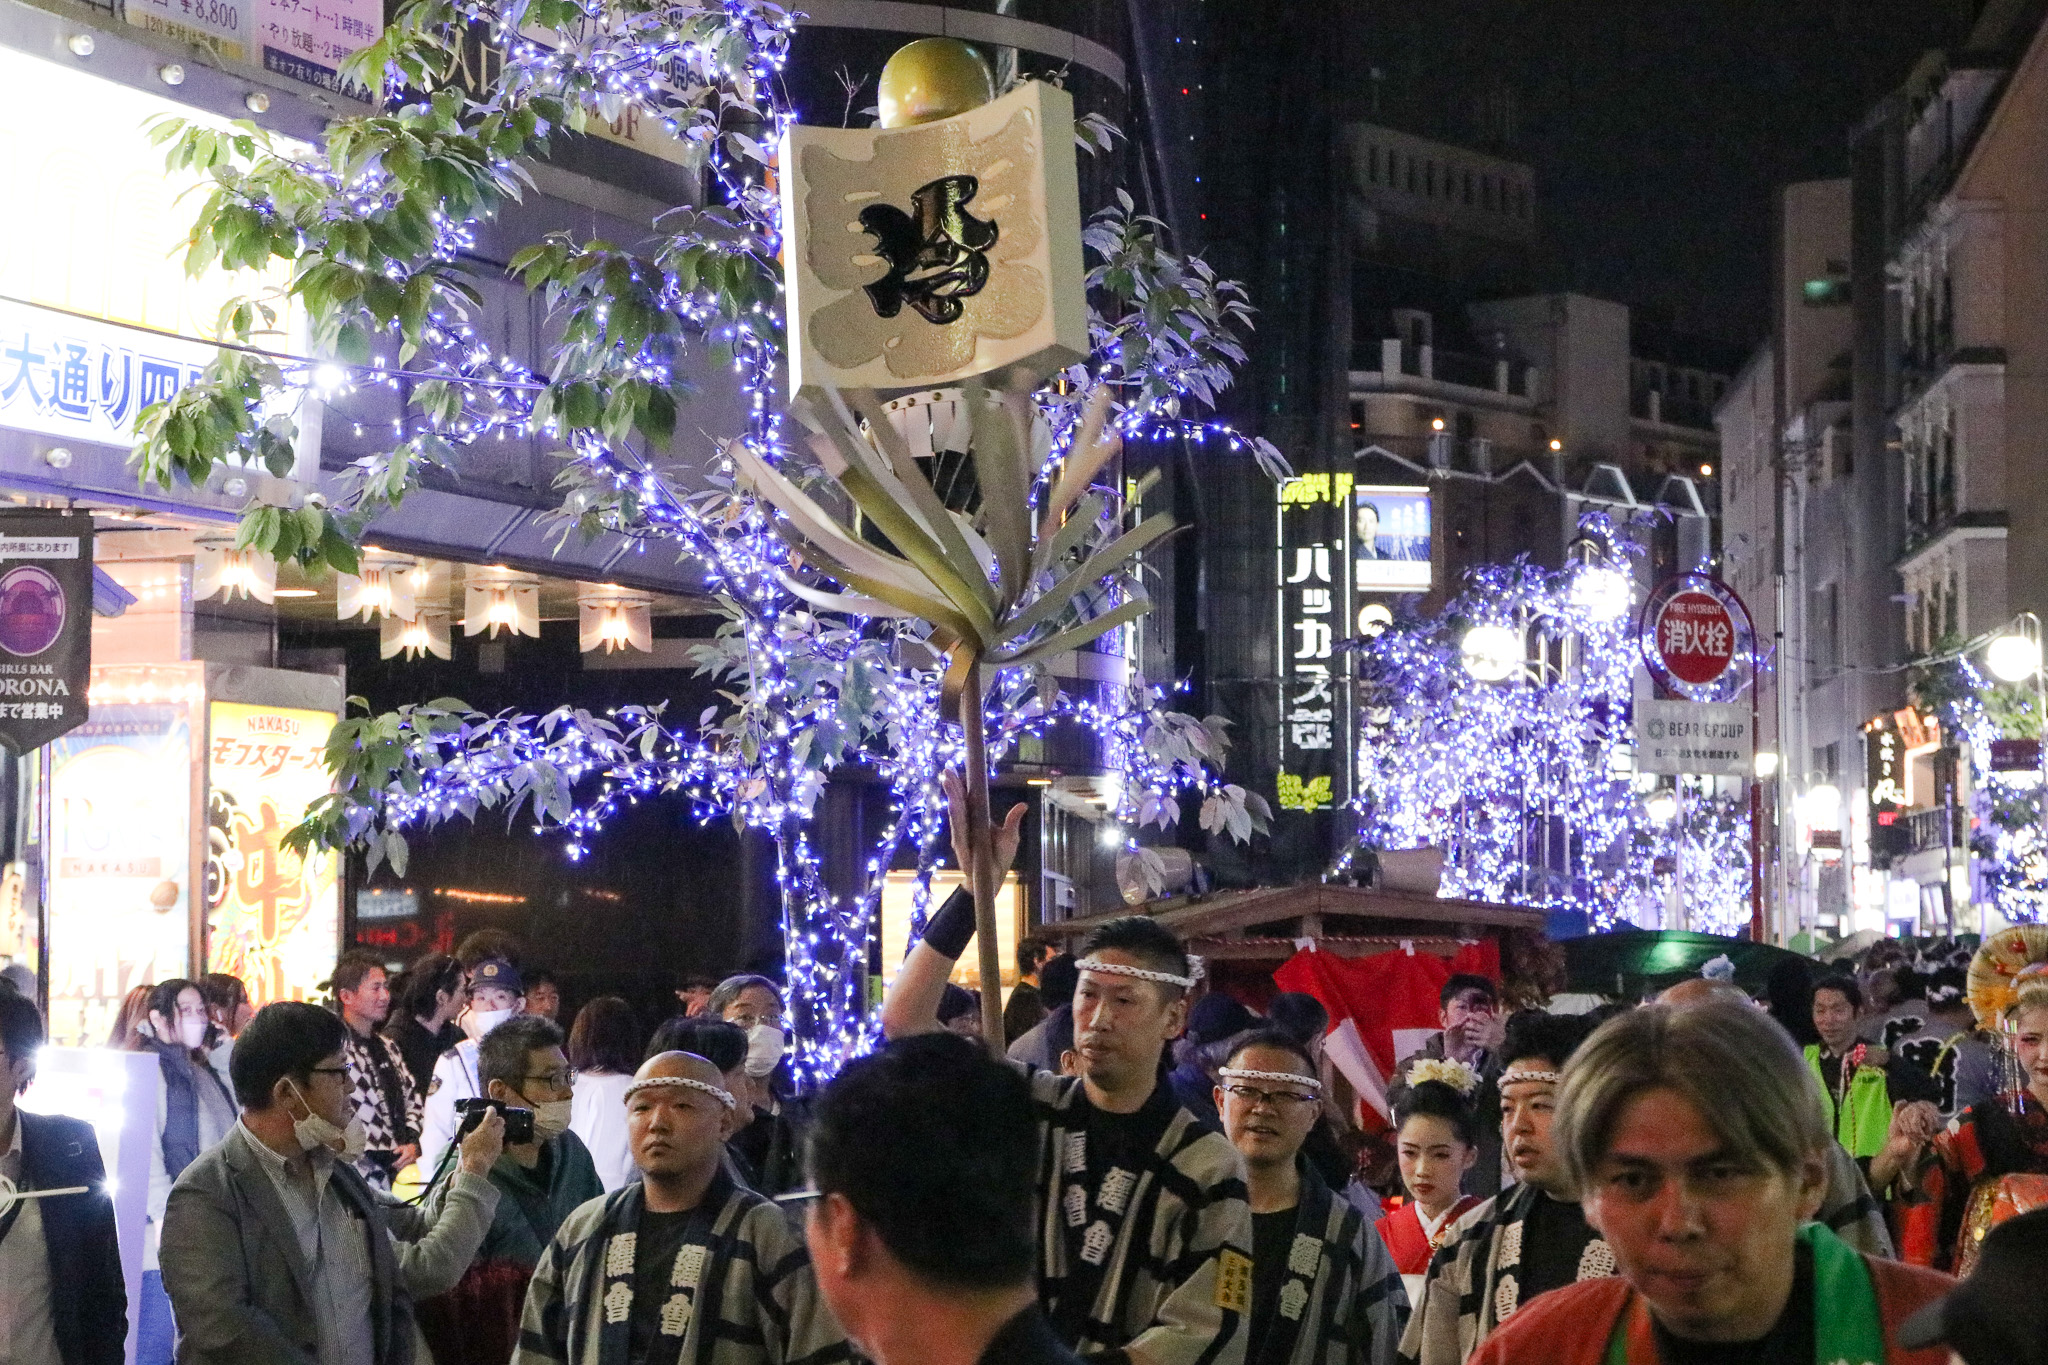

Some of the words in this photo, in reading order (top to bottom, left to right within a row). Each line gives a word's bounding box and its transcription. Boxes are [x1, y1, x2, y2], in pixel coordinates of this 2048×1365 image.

[1669, 602, 1686, 614] FIRE
[1687, 603, 1721, 615] HYDRANT
[1664, 619, 1730, 656] 消火栓
[0, 664, 28, 675] IRLS
[29, 664, 54, 675] BAR
[247, 715, 300, 736] NAKASU
[1669, 721, 1699, 738] BEAR
[72, 861, 148, 875] NAKASU
